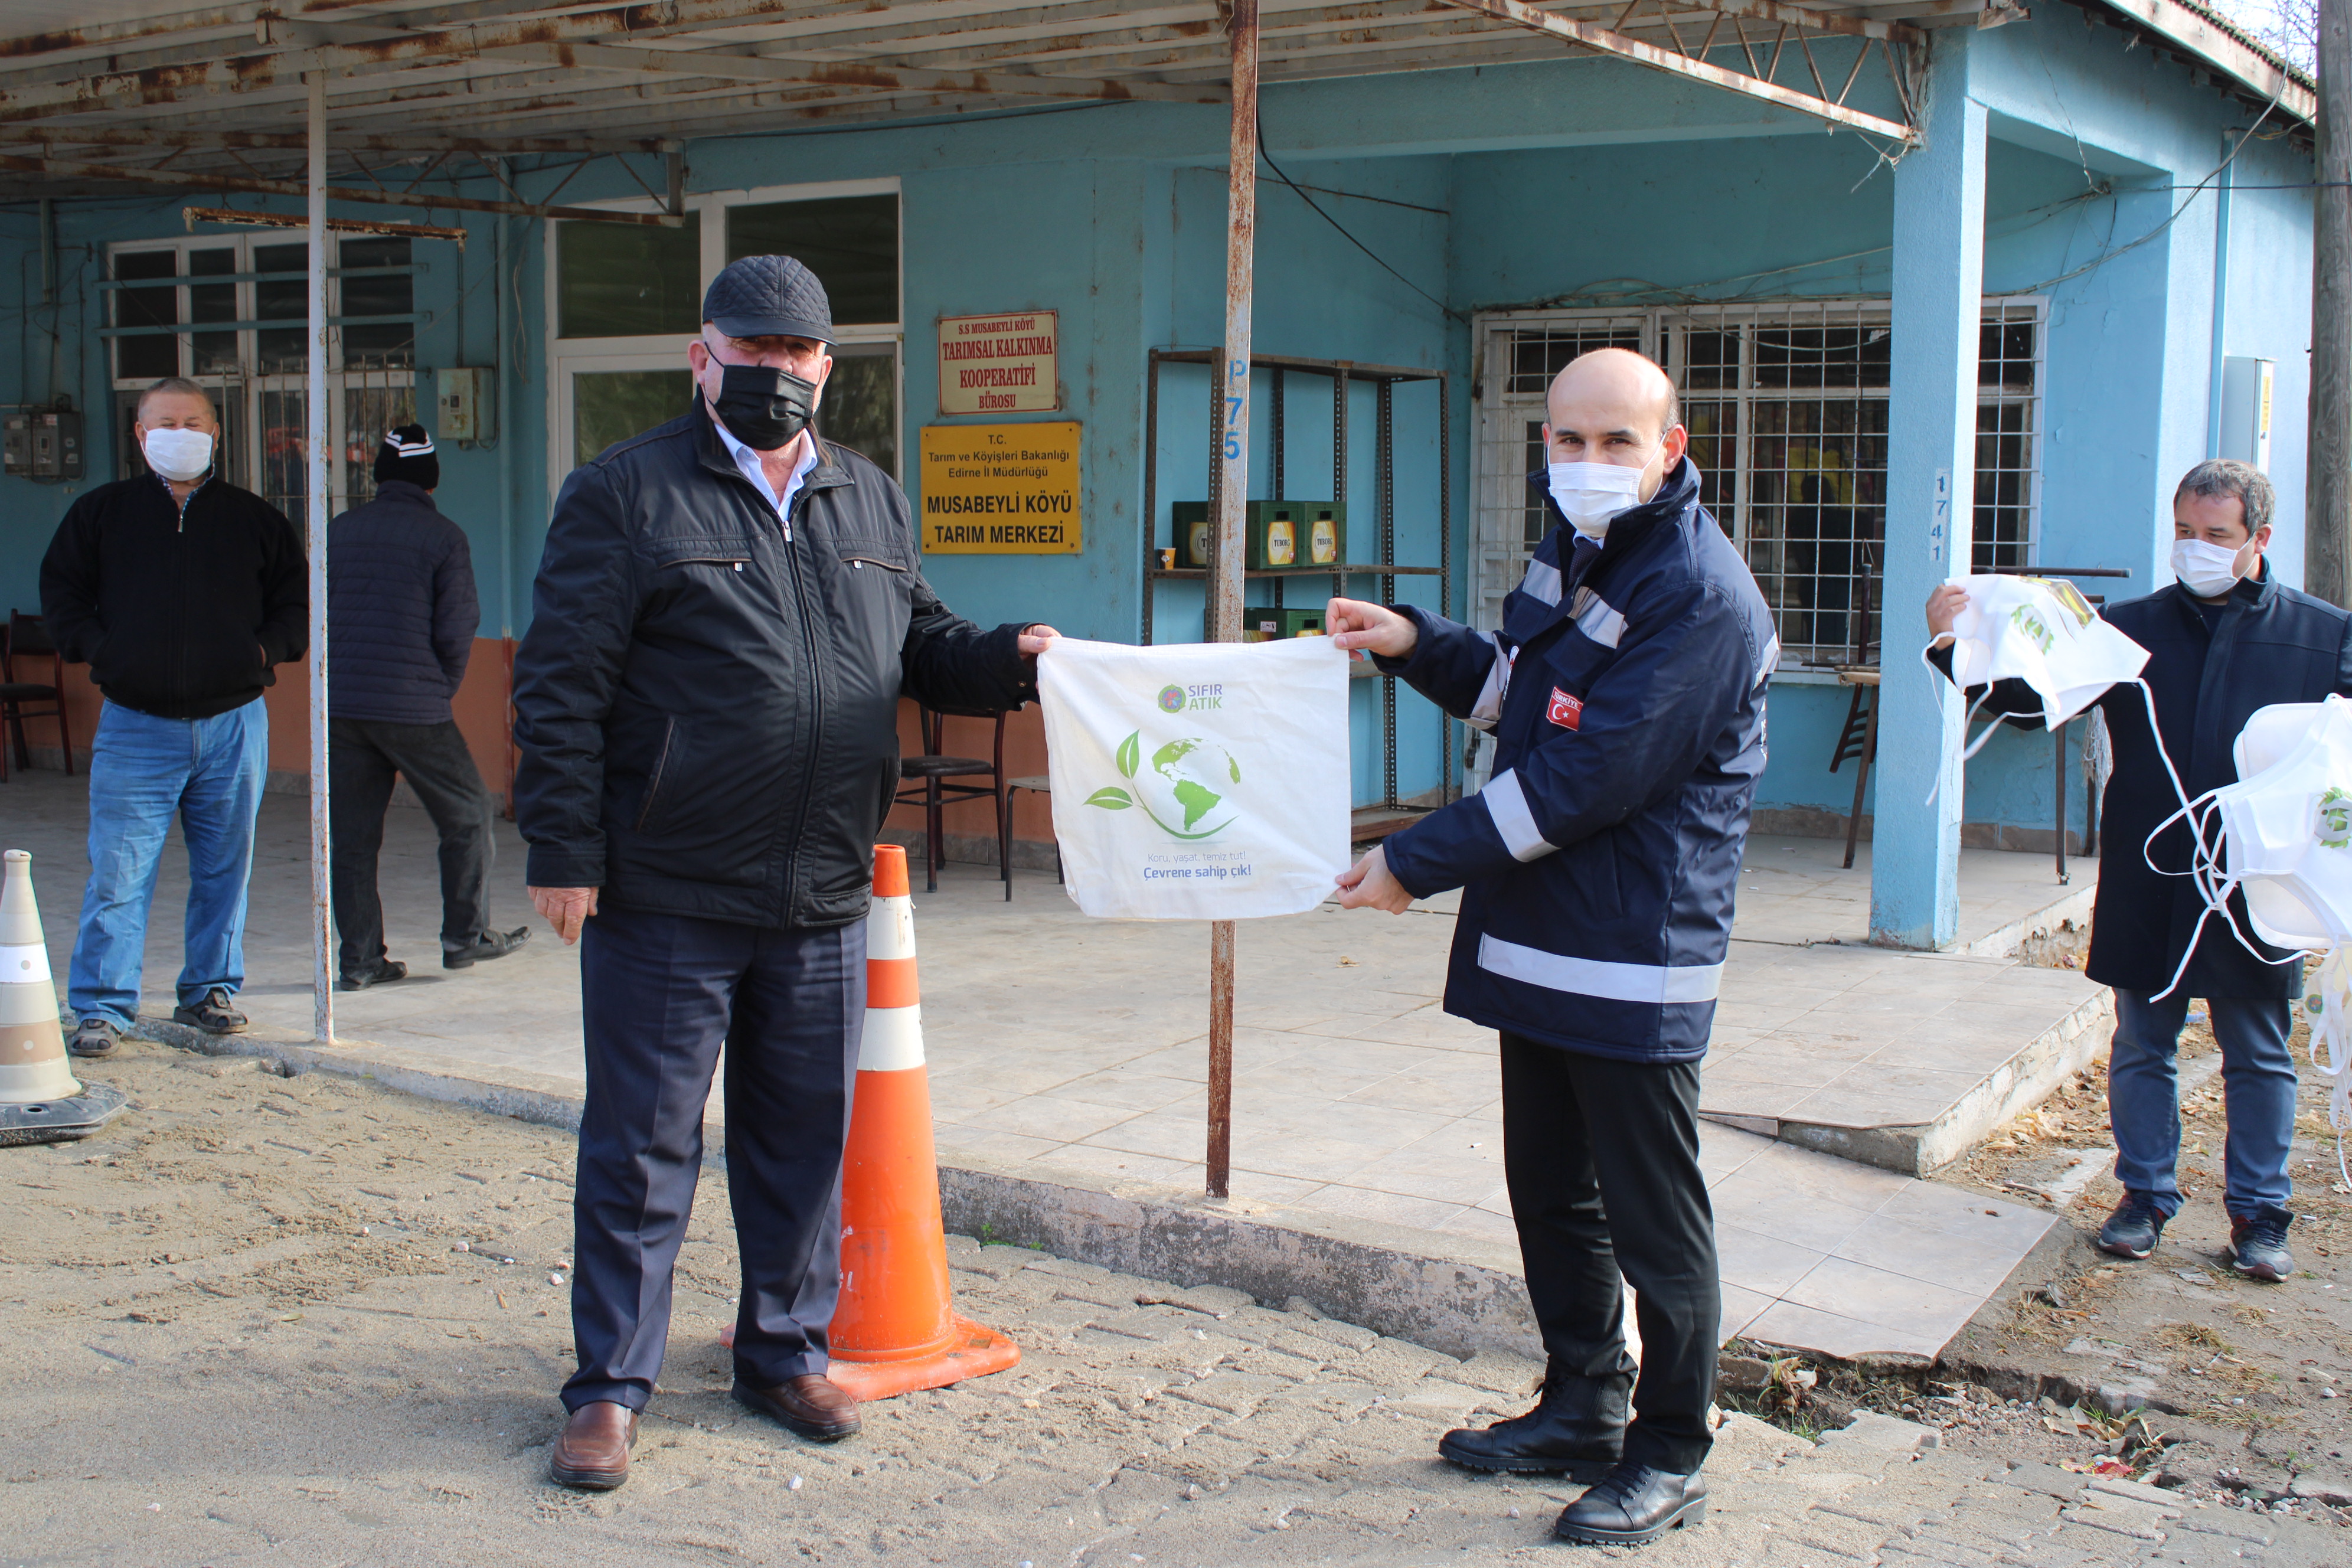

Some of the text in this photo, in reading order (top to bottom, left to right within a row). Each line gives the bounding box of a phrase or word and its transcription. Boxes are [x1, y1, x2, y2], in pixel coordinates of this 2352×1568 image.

[958, 317, 1035, 335] S.S MUSABEYLİ KÖYÜ
[943, 336, 1053, 361] TARIMSAL KALKINMA
[959, 362, 1036, 388] KOOPERATİFİ
[978, 390, 1016, 409] BÜROSU
[988, 435, 1007, 445] T.C.
[929, 450, 1069, 463] Tarım ve Köyişleri Bakanlığı
[949, 465, 1048, 479] Edirne İl Müdürlüğü
[927, 489, 1072, 514] MUSABEYLİ KÖYÜ
[935, 520, 1063, 543] TARIM MERKEZİ
[1274, 539, 1290, 547] TUBORG
[1188, 684, 1223, 697] SIFIR
[1554, 690, 1578, 708] TÜRKİYE
[1188, 697, 1223, 711] ATIK
[1148, 851, 1246, 864] Koru, yaşat, temiz tut!
[1144, 864, 1252, 881] Çevrene sahip çık!
